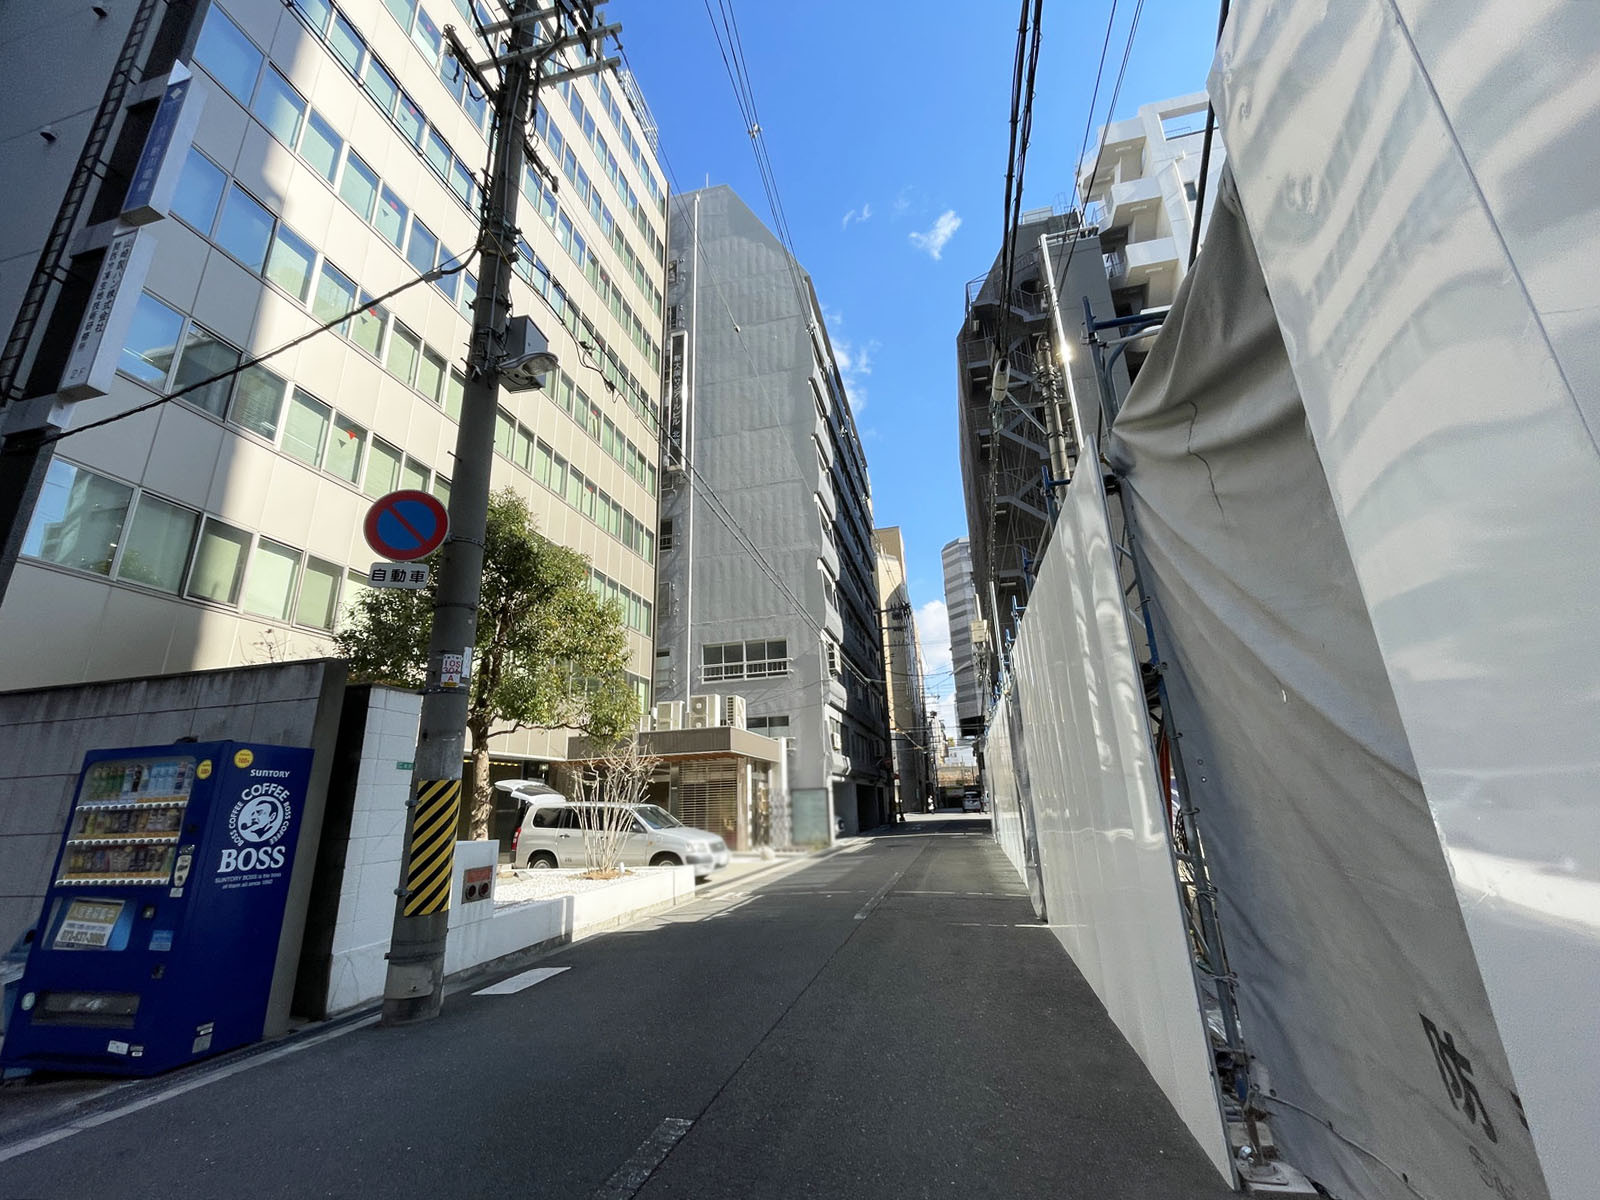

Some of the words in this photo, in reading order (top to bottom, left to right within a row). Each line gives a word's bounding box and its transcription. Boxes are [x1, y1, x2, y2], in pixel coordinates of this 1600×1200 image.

[371, 568, 427, 584] 自動車
[250, 769, 290, 778] SUNTORY
[241, 783, 290, 801] COFFEE
[228, 801, 244, 829] COFFEE
[283, 801, 292, 820] BOSS
[229, 828, 244, 847] BOSS
[270, 821, 290, 845] COFFEE
[217, 846, 286, 873] BOSS
